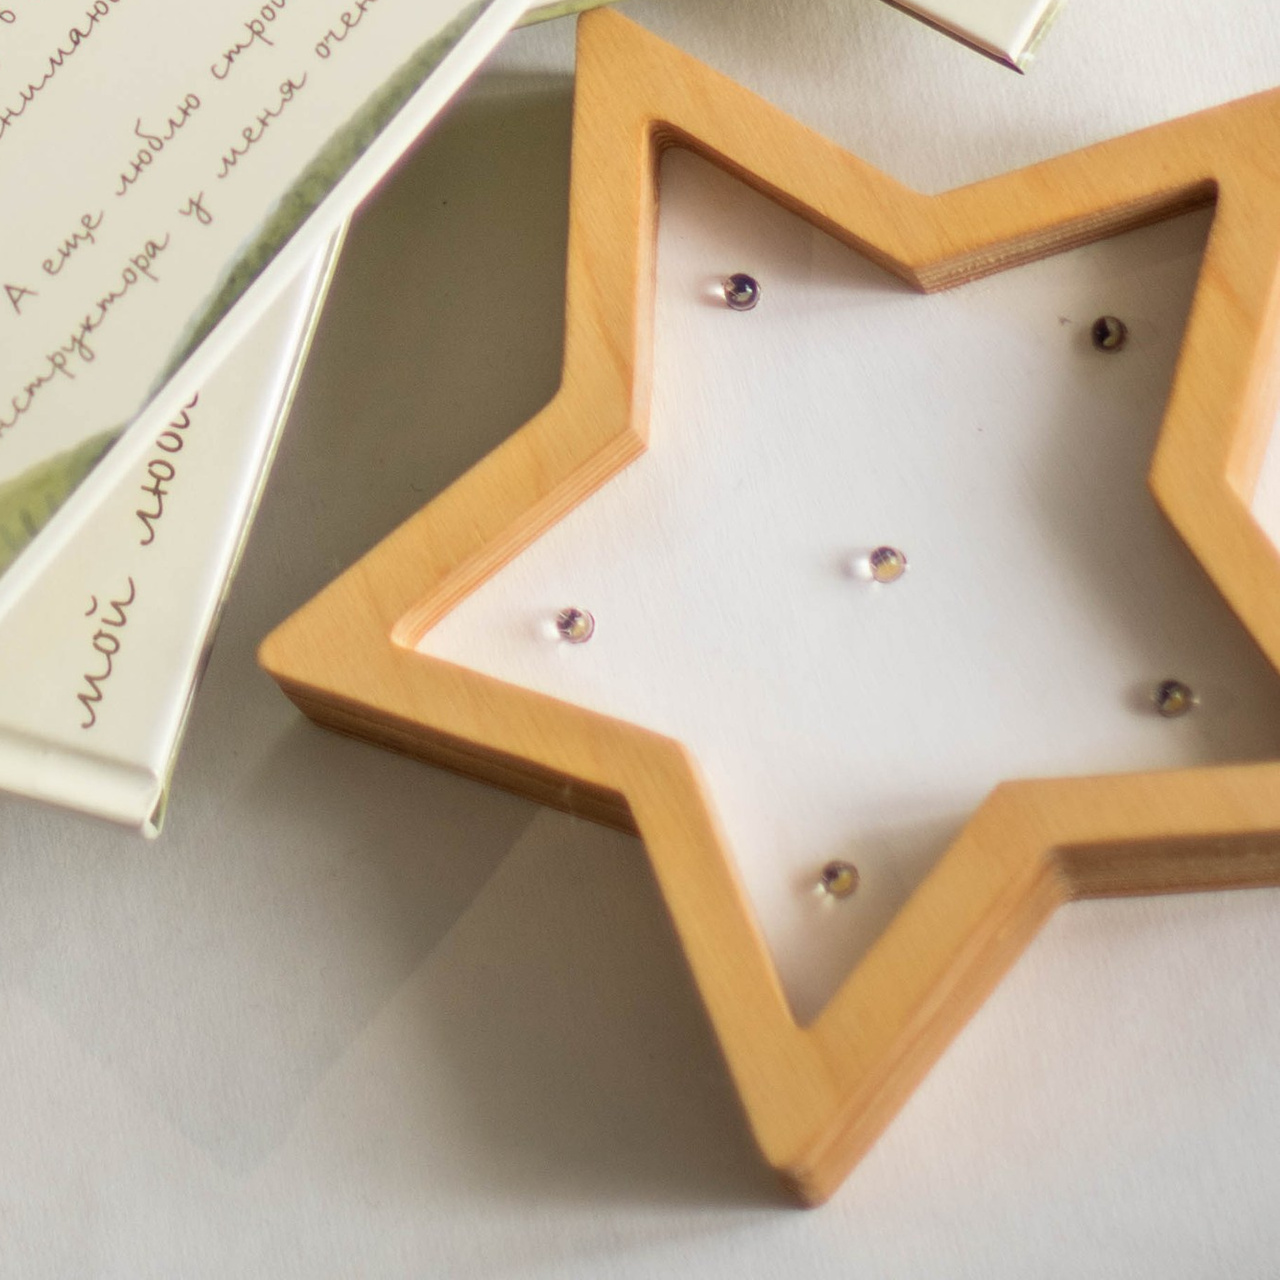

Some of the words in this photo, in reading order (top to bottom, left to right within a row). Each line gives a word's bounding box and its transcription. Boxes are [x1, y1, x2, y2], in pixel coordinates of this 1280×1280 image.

[3, 282, 38, 314] А
[42, 212, 103, 277] еще
[115, 92, 200, 196] люблю
[179, 190, 212, 225] у
[217, 72, 307, 179] меня
[81, 577, 136, 729] мой
